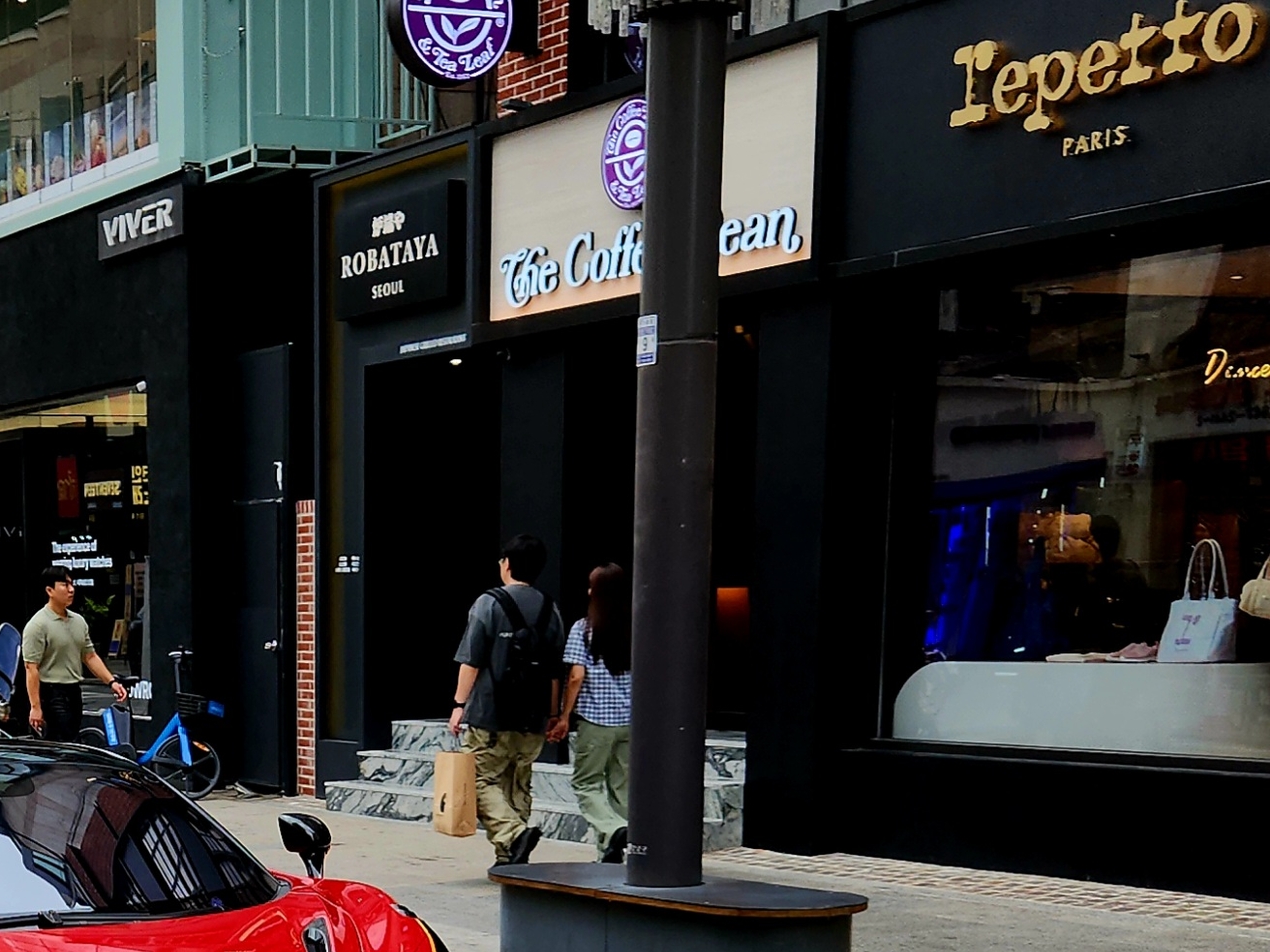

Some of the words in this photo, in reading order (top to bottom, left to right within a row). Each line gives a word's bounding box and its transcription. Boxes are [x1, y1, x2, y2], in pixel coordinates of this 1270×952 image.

[431, 47, 458, 72] Tea
[458, 36, 496, 72] Leaf
[949, 0, 1255, 132] repetto
[1062, 125, 1131, 157] PARIS
[102, 198, 173, 247] VIVER
[340, 232, 439, 279] ROBATAYA
[500, 244, 559, 309] The
[371, 279, 405, 300] SEOUL
